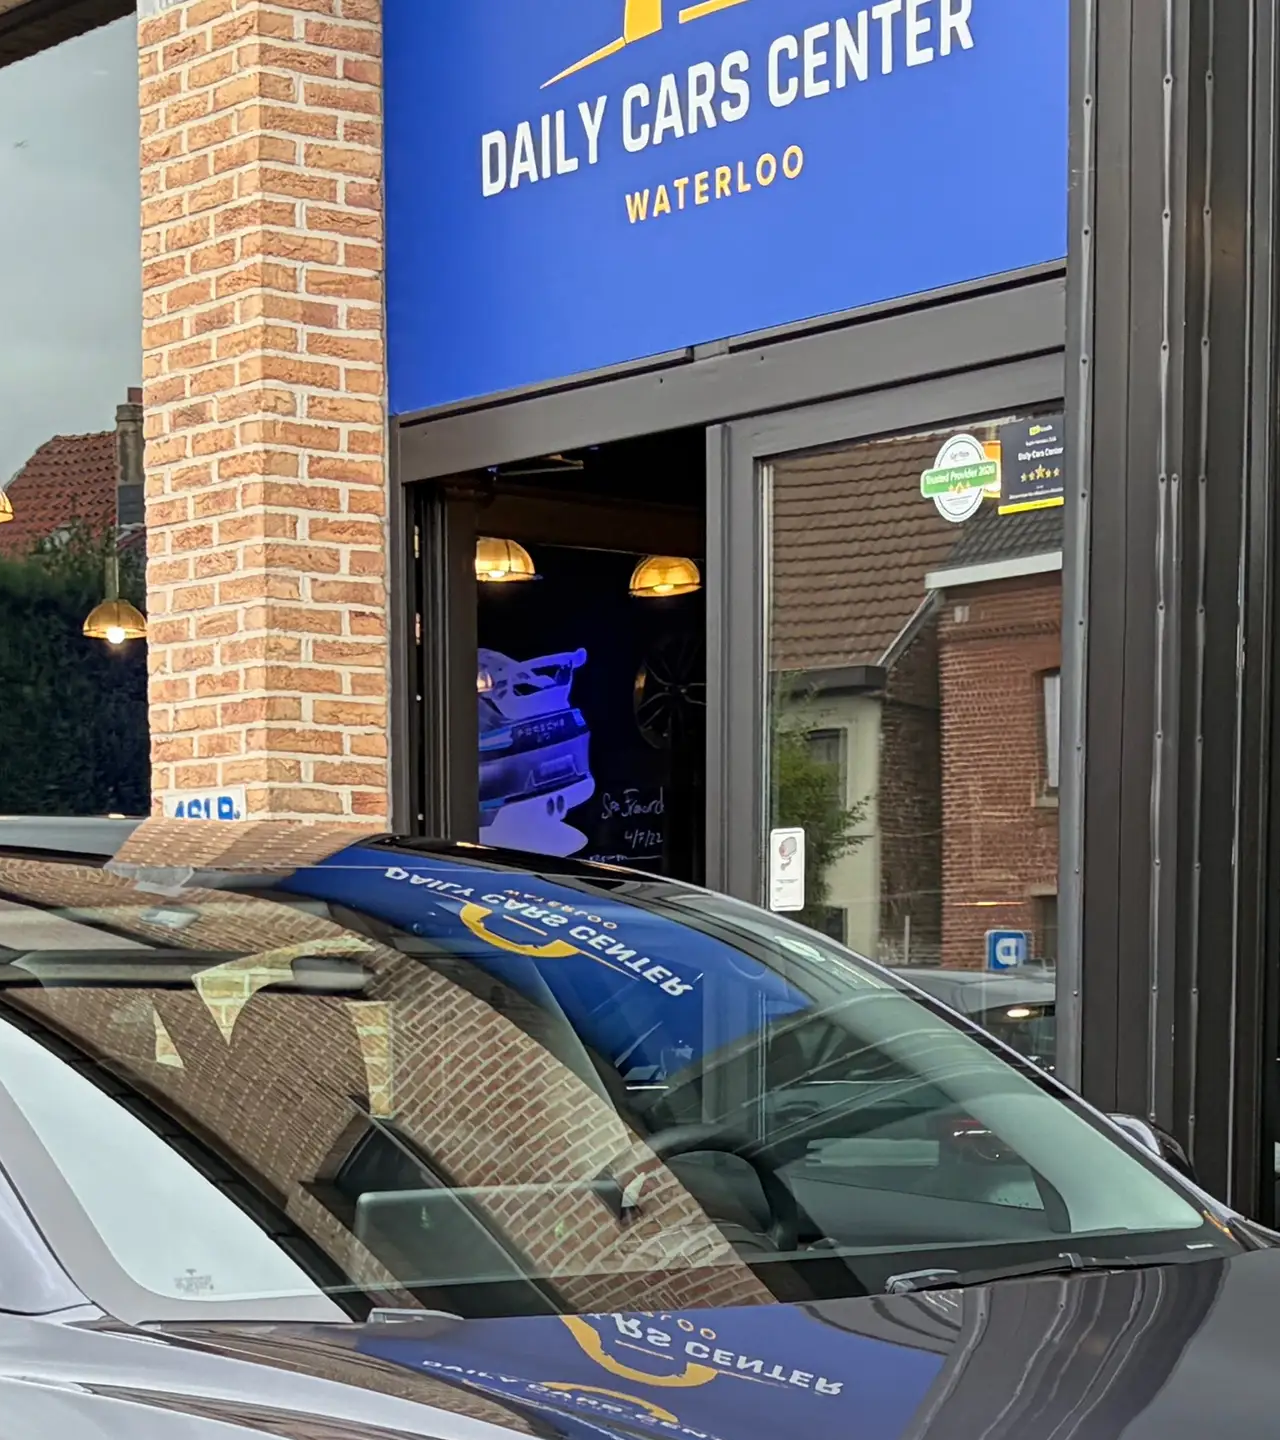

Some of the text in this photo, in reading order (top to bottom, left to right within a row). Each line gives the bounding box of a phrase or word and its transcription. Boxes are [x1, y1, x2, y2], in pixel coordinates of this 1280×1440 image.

[481, 0, 975, 198] DAILY CARS CENTER
[625, 144, 805, 225] WATERLOO
